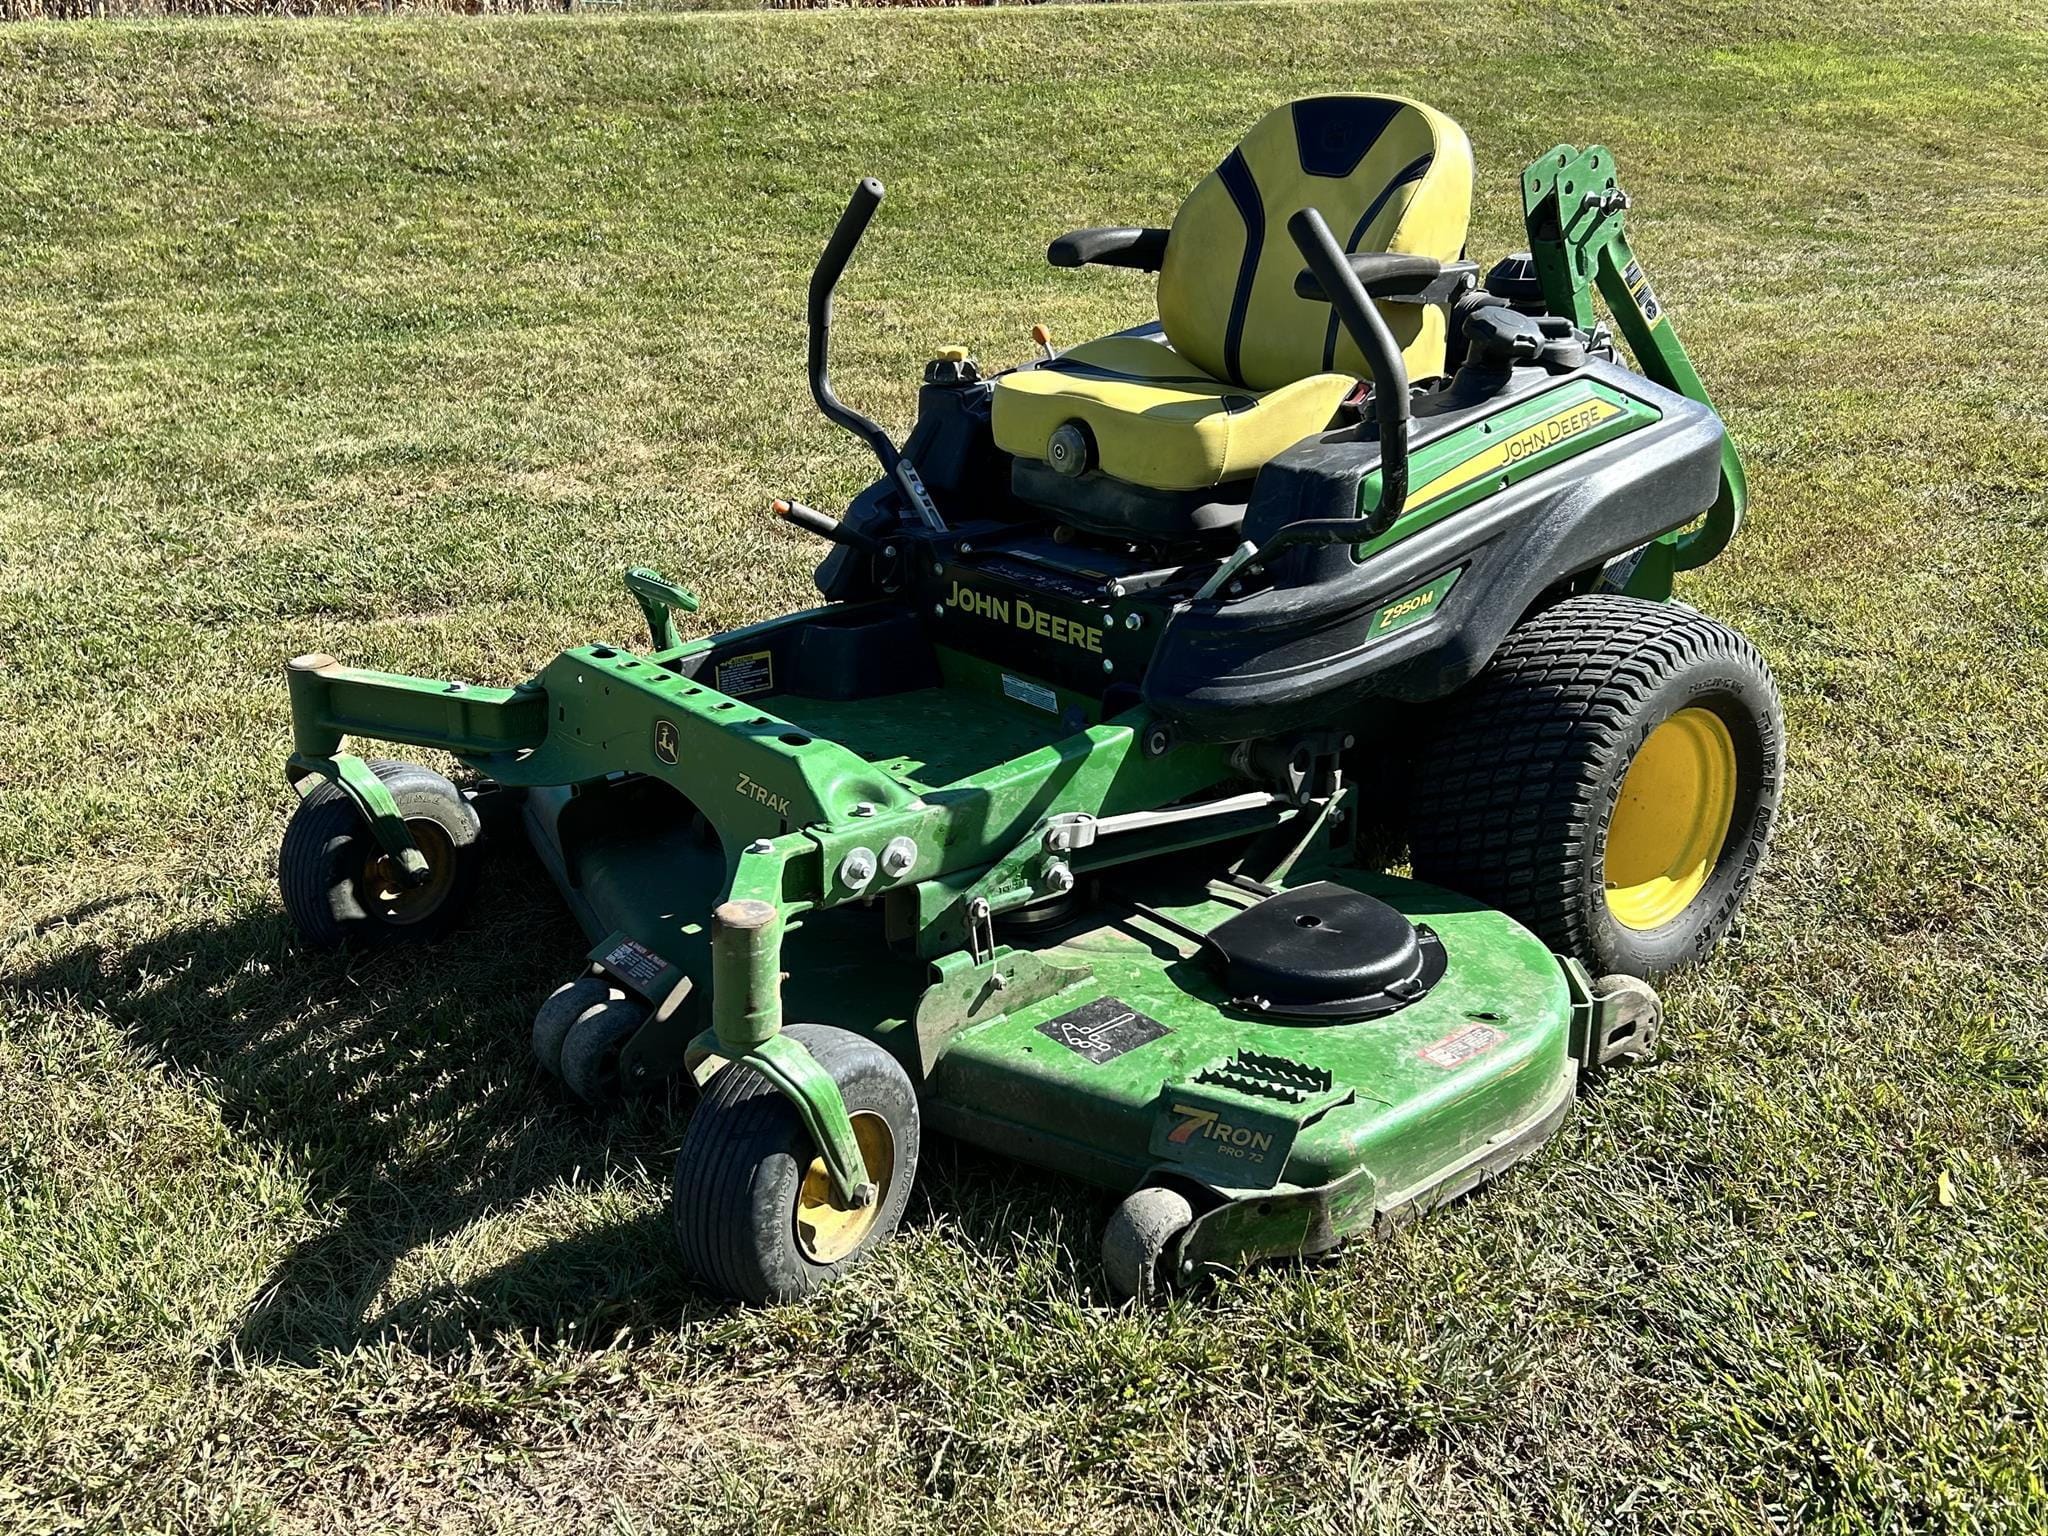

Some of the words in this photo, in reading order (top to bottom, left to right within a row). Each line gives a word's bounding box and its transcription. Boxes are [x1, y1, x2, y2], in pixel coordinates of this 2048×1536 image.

[1502, 430, 1545, 464] JOHN
[1548, 405, 1600, 441] DEERE
[946, 580, 1010, 625] JOHN
[1016, 600, 1103, 654] DEERE
[1379, 590, 1434, 628] Z950M
[1756, 710, 1776, 797] TURF
[736, 773, 791, 815] ZTRAK
[1695, 806, 1772, 952] MASTER
[1217, 1145, 1245, 1158] PRO
[1248, 1152, 1265, 1164] 72
